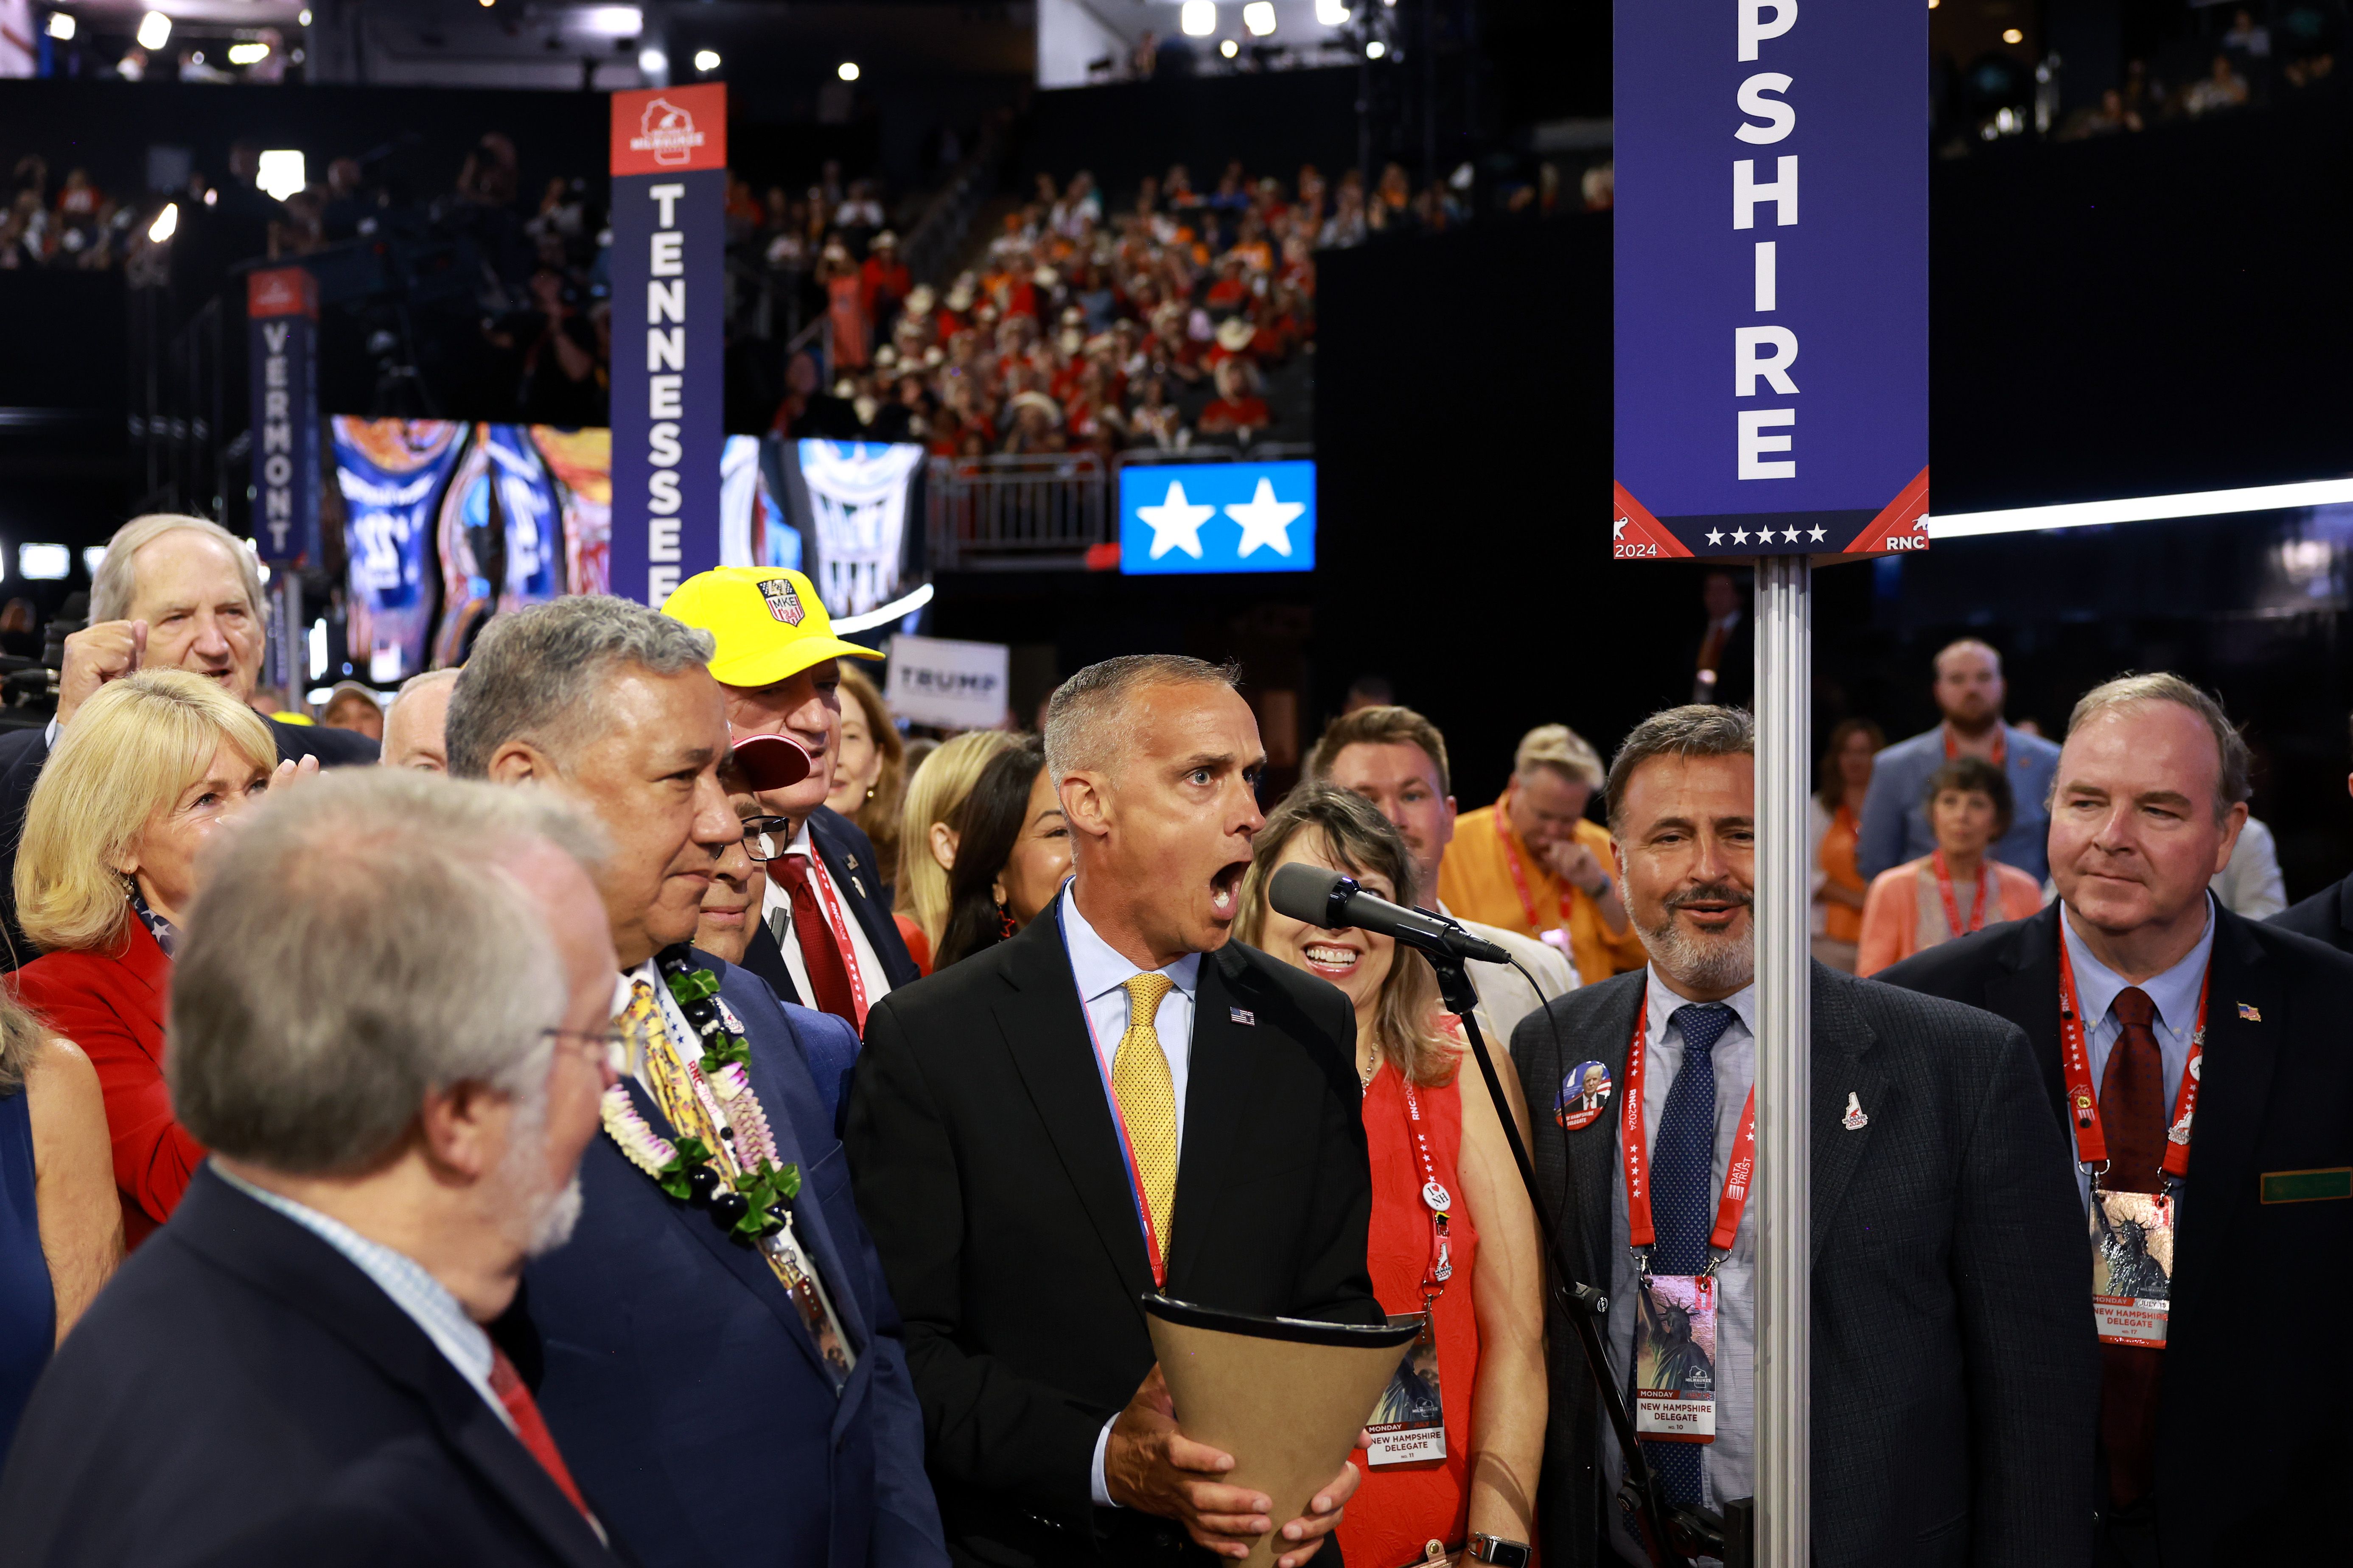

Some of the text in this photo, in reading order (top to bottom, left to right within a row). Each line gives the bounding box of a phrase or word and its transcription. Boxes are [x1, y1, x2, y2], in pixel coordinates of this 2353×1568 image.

[1734, 0, 1800, 480] PSHIRE
[647, 183, 685, 608] TENNESSEE
[263, 322, 293, 553] VERMONT
[1886, 536, 1925, 550] RNC
[1615, 544, 1657, 557] 2024
[772, 597, 797, 608] MKE
[902, 666, 996, 692] TRUMP
[687, 1060, 717, 1115] RNC2024
[1628, 1089, 1637, 1131] RNC2024
[1730, 1162, 1743, 1184] DATA
[1737, 1156, 1751, 1184] TRUST
[1427, 1187, 1435, 1196] I
[1431, 1193, 1449, 1207] NH
[2116, 1310, 2168, 1321] HAMPSHIRE
[2107, 1317, 2153, 1328] DELEGATE
[1663, 1404, 1712, 1413] HAMPSHIRE
[1655, 1413, 1698, 1422] DELEGATE
[1369, 1424, 1402, 1432] MONDAY
[1393, 1431, 1441, 1443] HAMPSHIRE
[1385, 1442, 1428, 1452] DELEGATE
